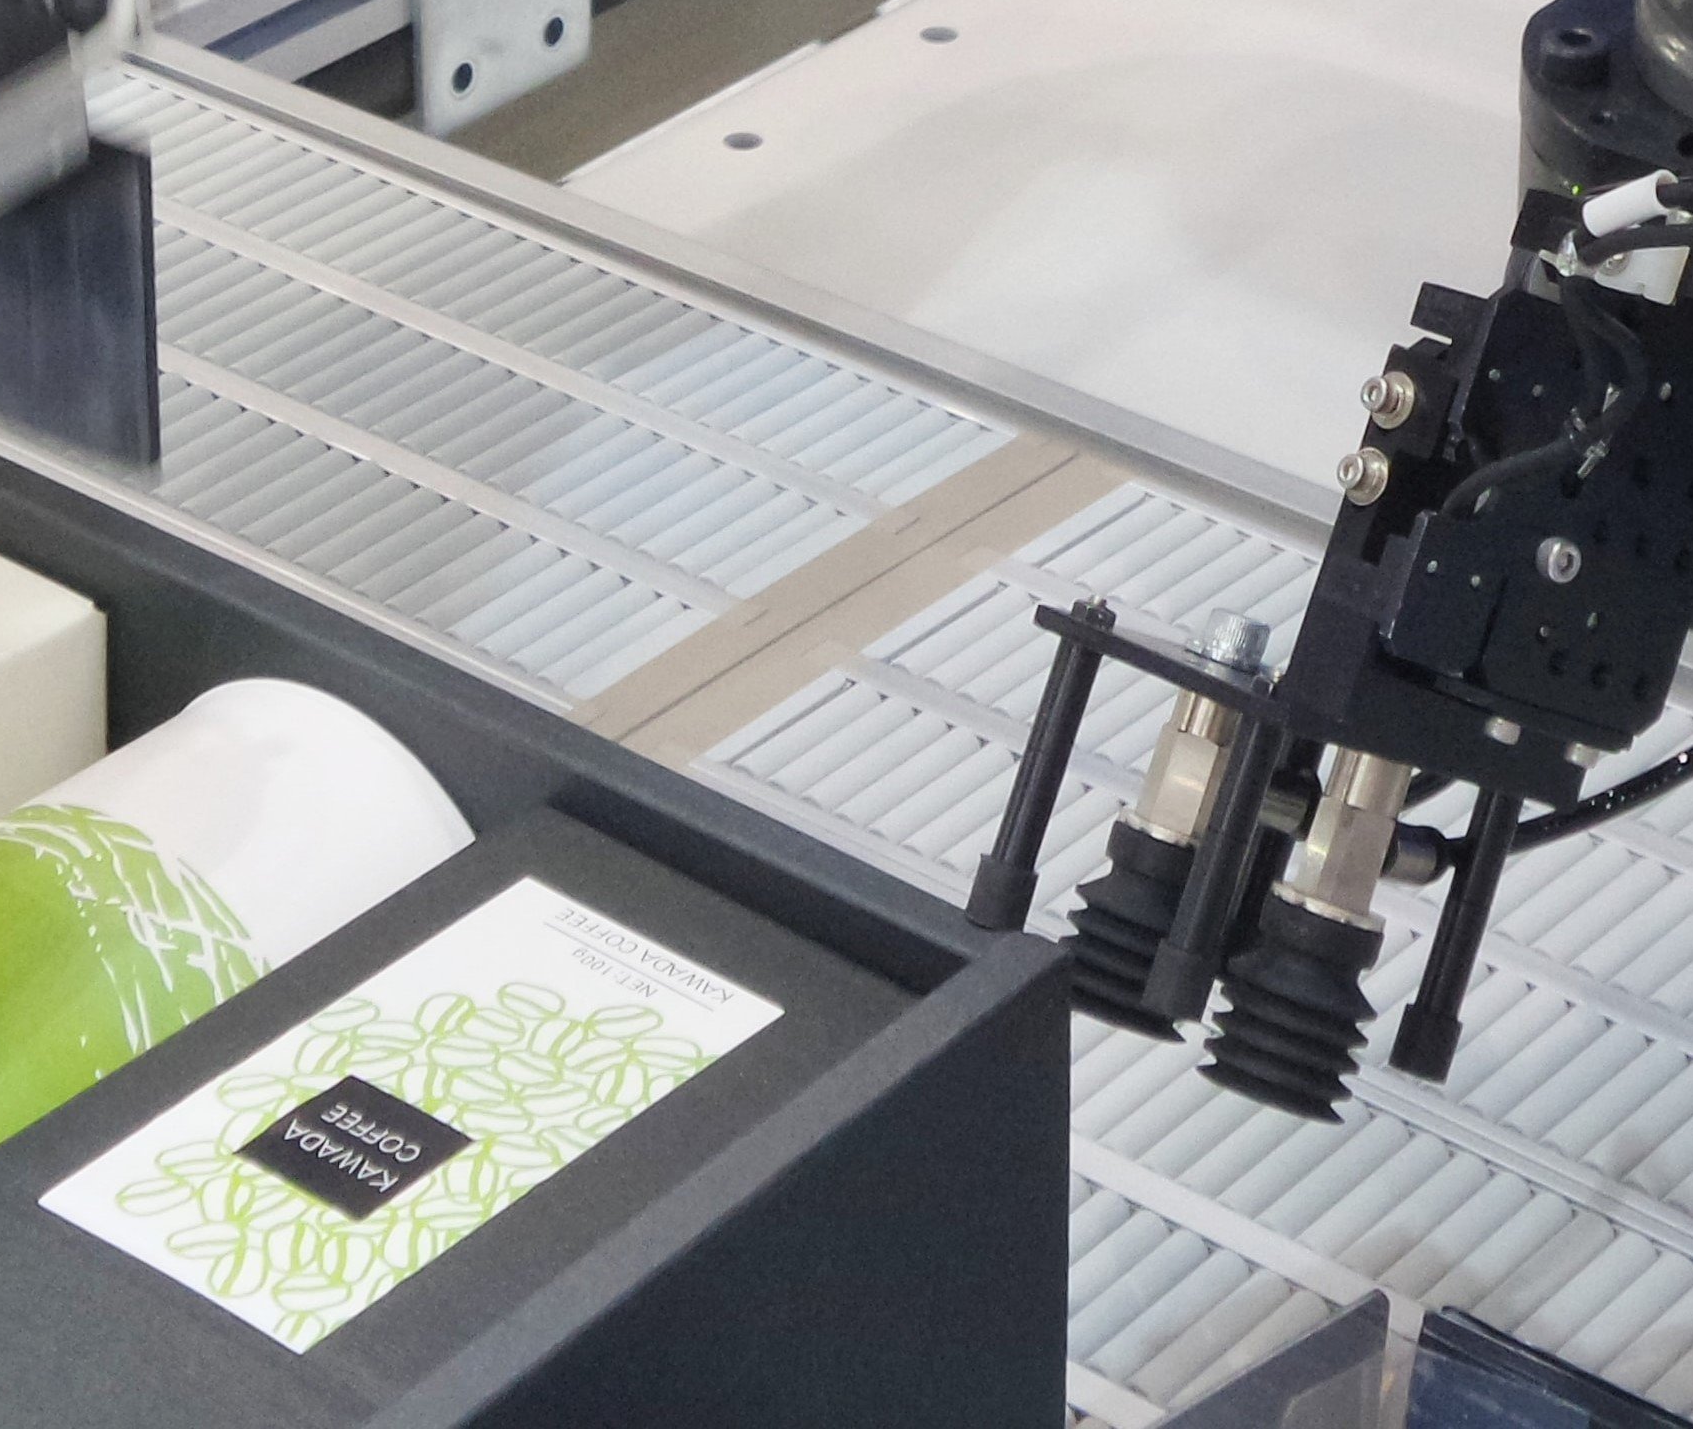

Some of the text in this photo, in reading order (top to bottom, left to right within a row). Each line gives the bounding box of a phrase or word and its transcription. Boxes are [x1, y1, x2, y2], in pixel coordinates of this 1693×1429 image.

[555, 907, 735, 1003] KAWADA COFFEE
[283, 1117, 399, 1194] KAWADA
[320, 1101, 422, 1163] COFFEE
